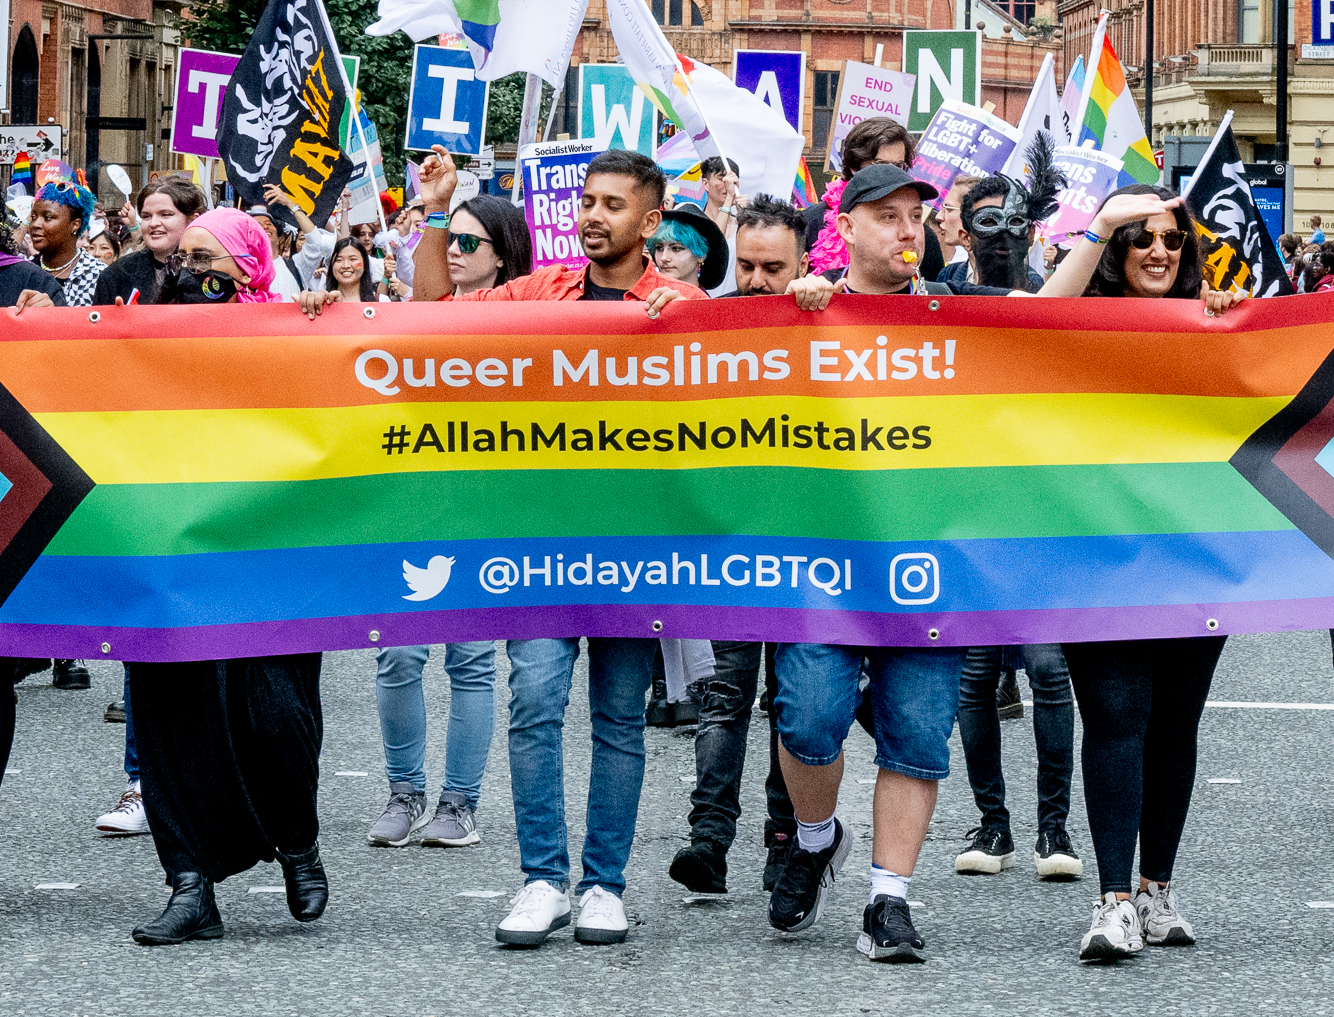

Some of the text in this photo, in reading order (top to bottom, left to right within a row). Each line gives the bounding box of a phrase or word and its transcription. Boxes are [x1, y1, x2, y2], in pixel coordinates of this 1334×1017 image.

[422, 64, 475, 135] I
[864, 77, 893, 93] END
[917, 48, 964, 114] N
[591, 84, 645, 151] W
[849, 94, 901, 116] SEXUAL
[927, 126, 979, 155] LGBT+
[936, 111, 1003, 150] Fight for
[918, 140, 990, 179] liberation
[532, 191, 582, 231] Righ
[354, 335, 958, 397] Queer Muslims Exist!
[381, 414, 933, 456] #AllahMakesNoMistakes
[479, 552, 852, 596] @HidayahLGBTQI
